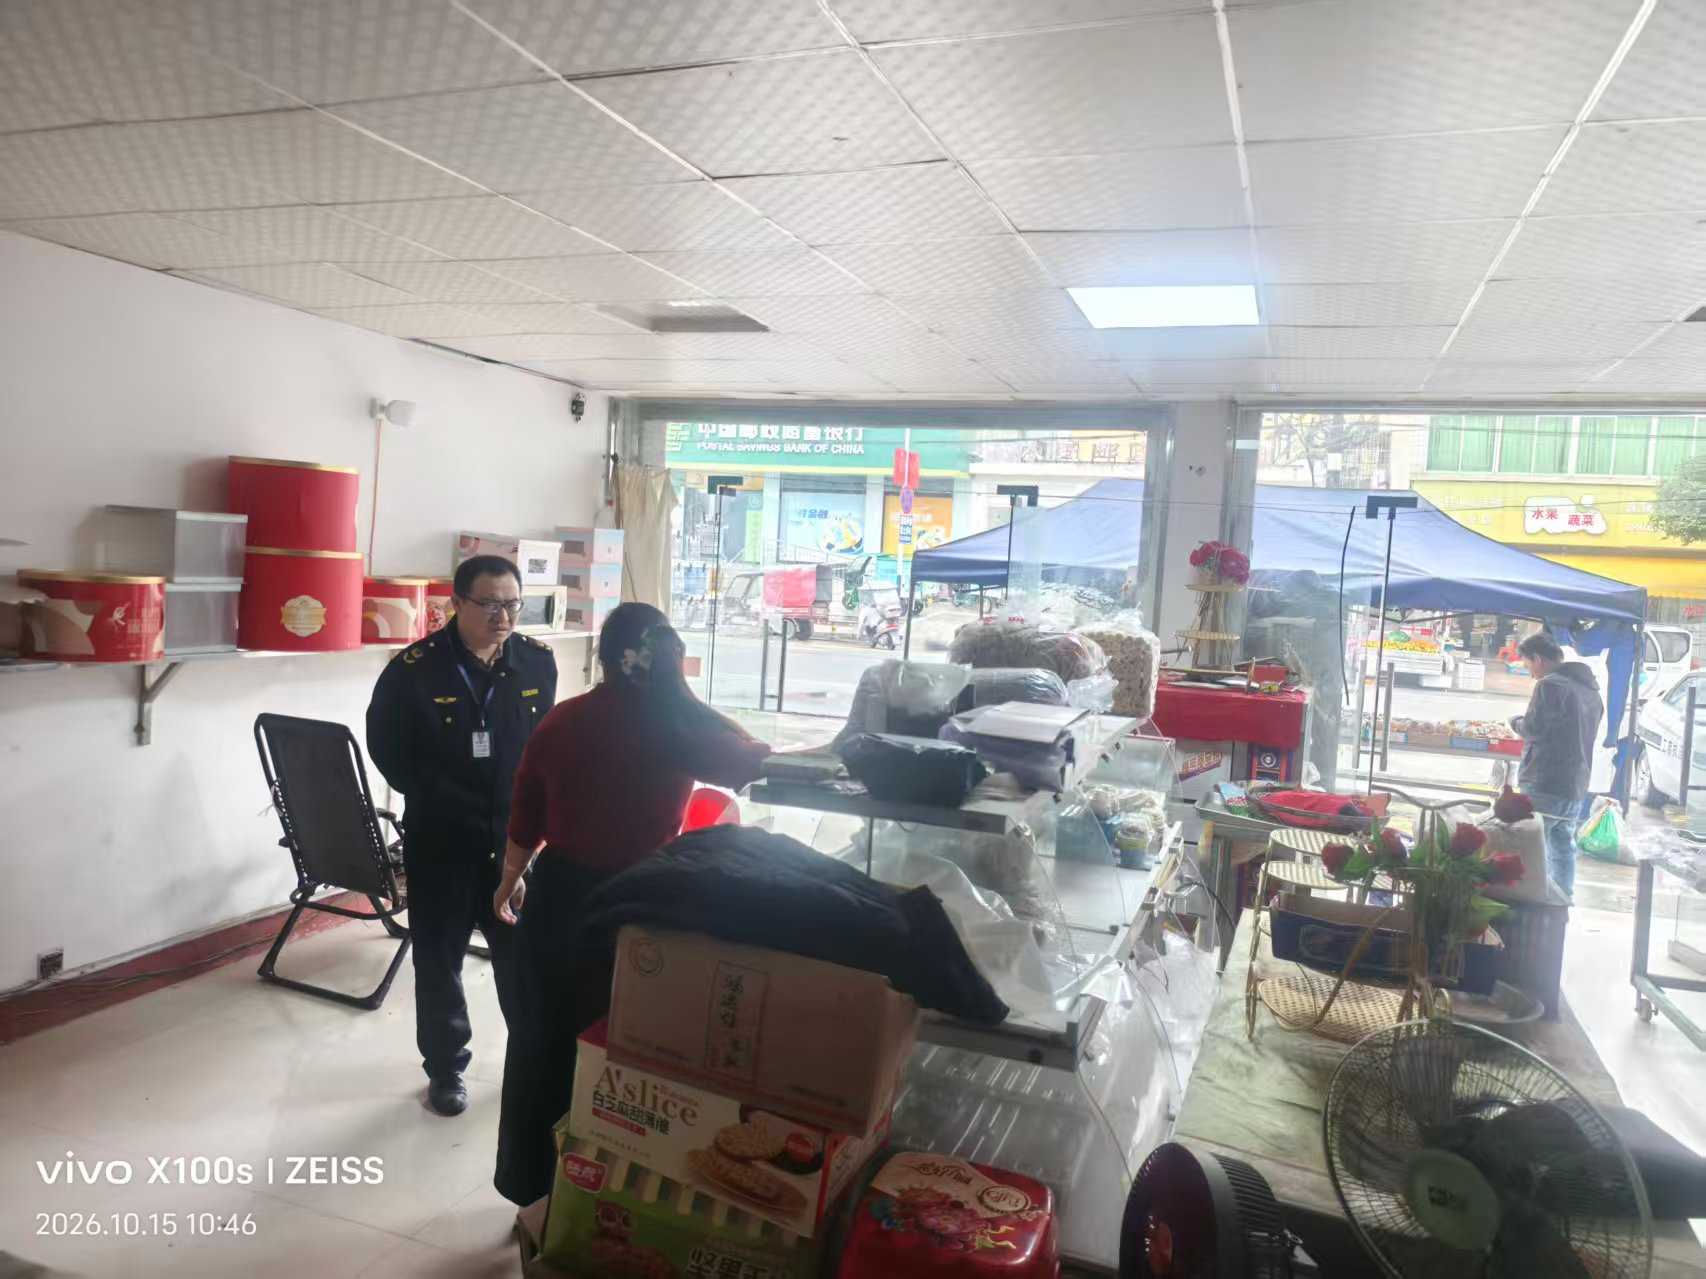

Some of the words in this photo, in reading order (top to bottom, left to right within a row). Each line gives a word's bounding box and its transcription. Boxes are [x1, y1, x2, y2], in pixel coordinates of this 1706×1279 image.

[783, 443, 812, 453] BANK
[814, 443, 828, 454] OF
[832, 444, 865, 455] CHINA
